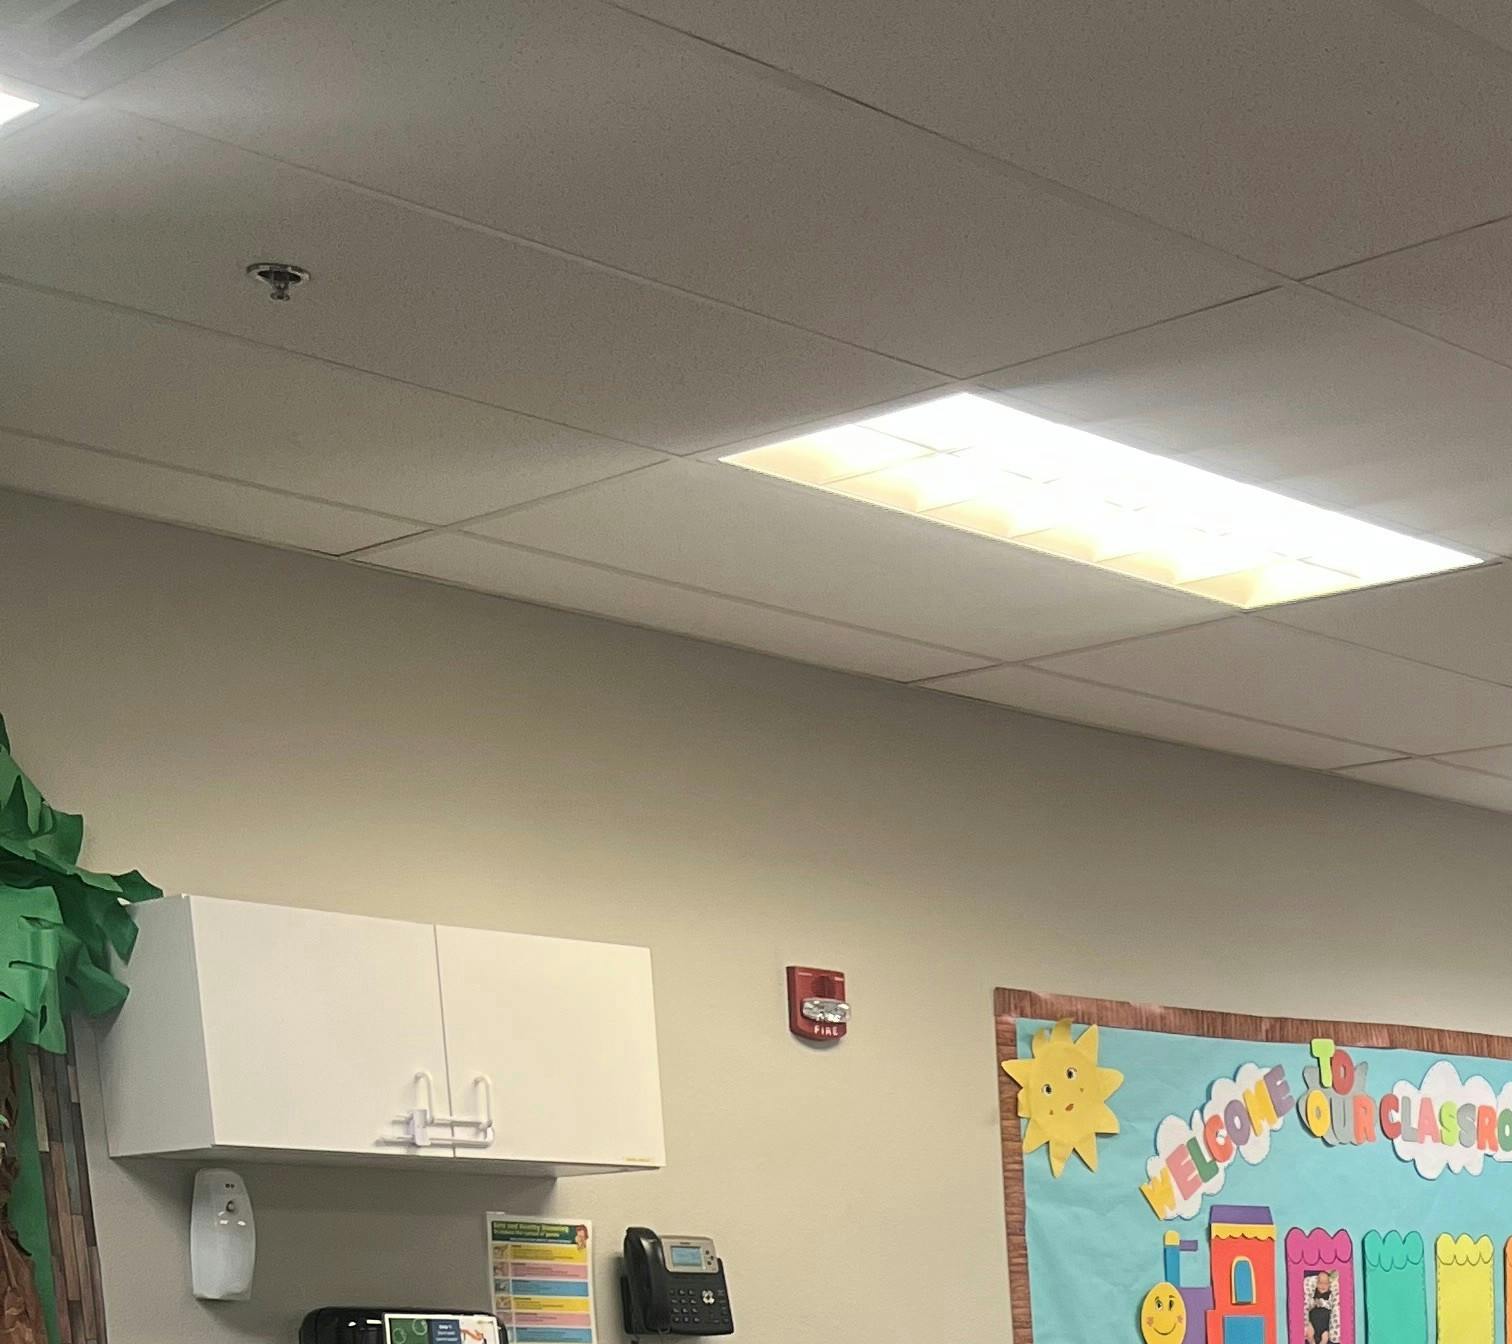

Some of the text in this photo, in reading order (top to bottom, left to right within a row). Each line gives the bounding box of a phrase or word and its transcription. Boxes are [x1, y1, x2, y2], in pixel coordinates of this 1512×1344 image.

[814, 1024, 839, 1036] FIRE
[1310, 1038, 1355, 1096] TO
[1138, 1064, 1296, 1221] WELCOME
[1306, 1089, 1377, 1145] OUR
